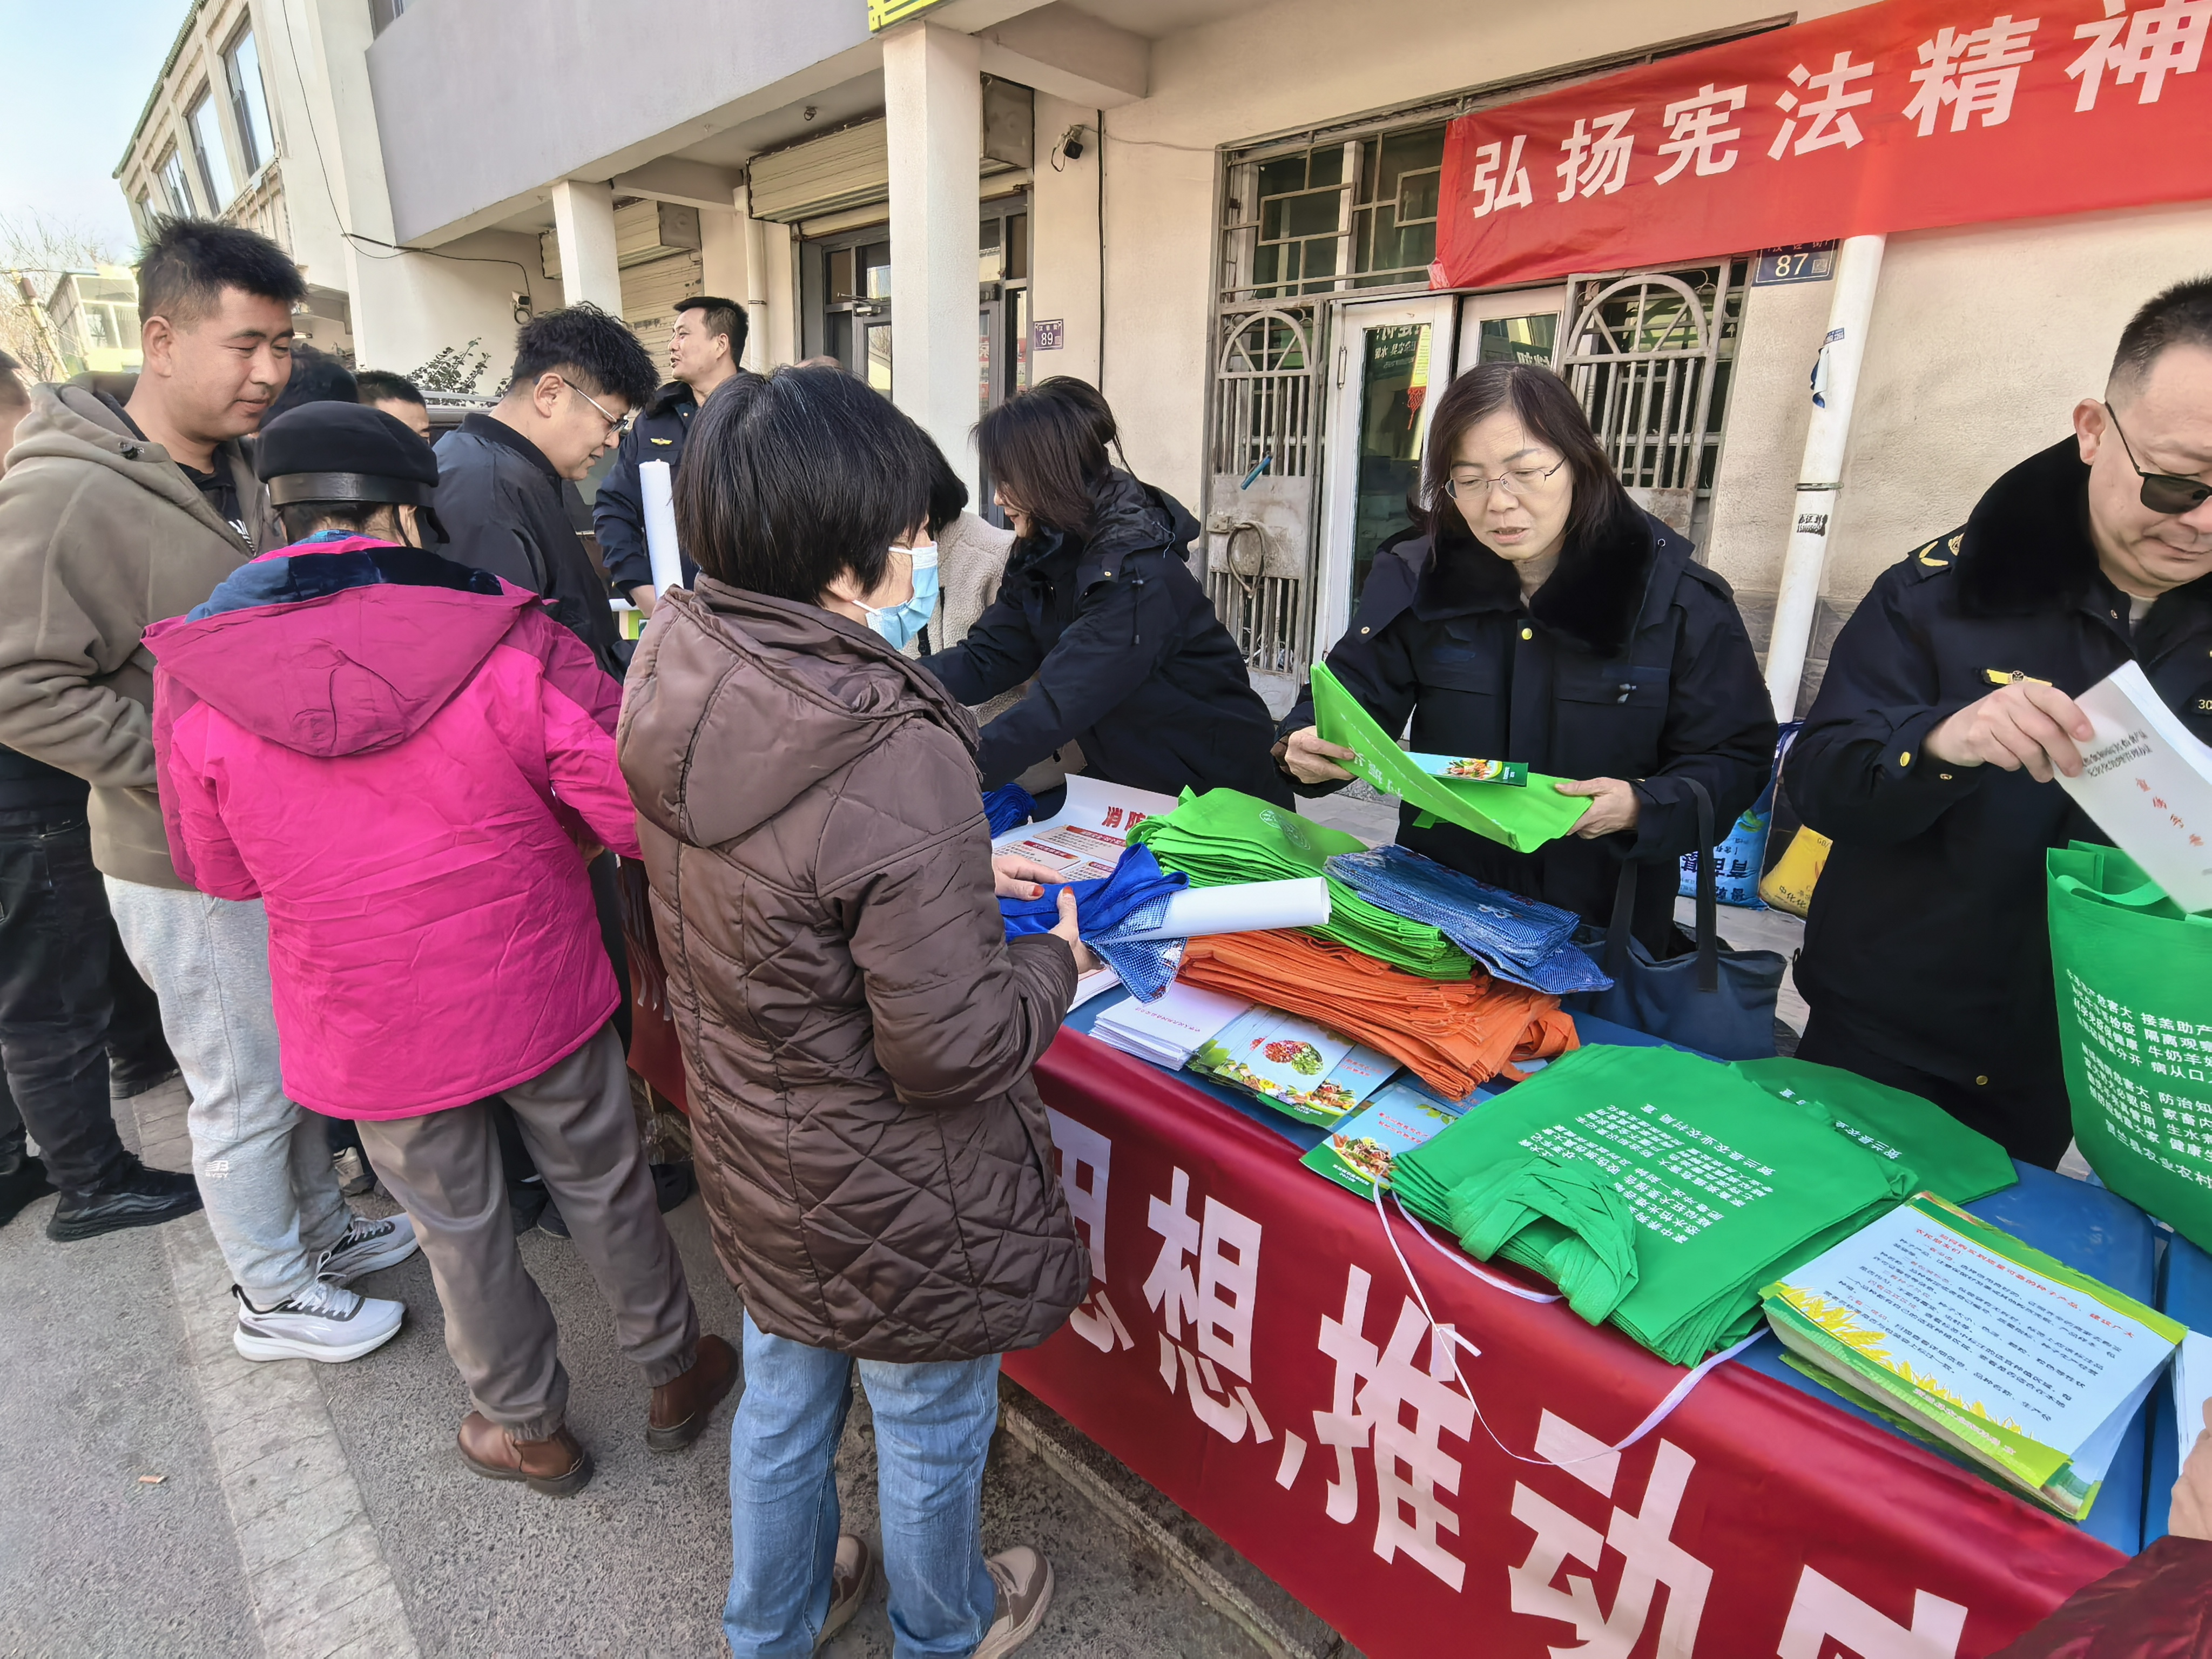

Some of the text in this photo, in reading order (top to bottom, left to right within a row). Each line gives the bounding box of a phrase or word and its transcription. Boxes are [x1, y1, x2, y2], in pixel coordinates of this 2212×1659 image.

[1472, 0, 2212, 217] 弘扬宪法精神
[1775, 253, 1809, 276] 87
[1041, 332, 1053, 346] 89
[1640, 1103, 1777, 1176] 贺兰县农业农村局 宣
[1619, 1174, 1715, 1228] 疑似狂犬要报告
[1630, 1166, 1727, 1220] 肥皂冲洗一刻钟
[1654, 1157, 1748, 1209] 家畜炭疽危害大
